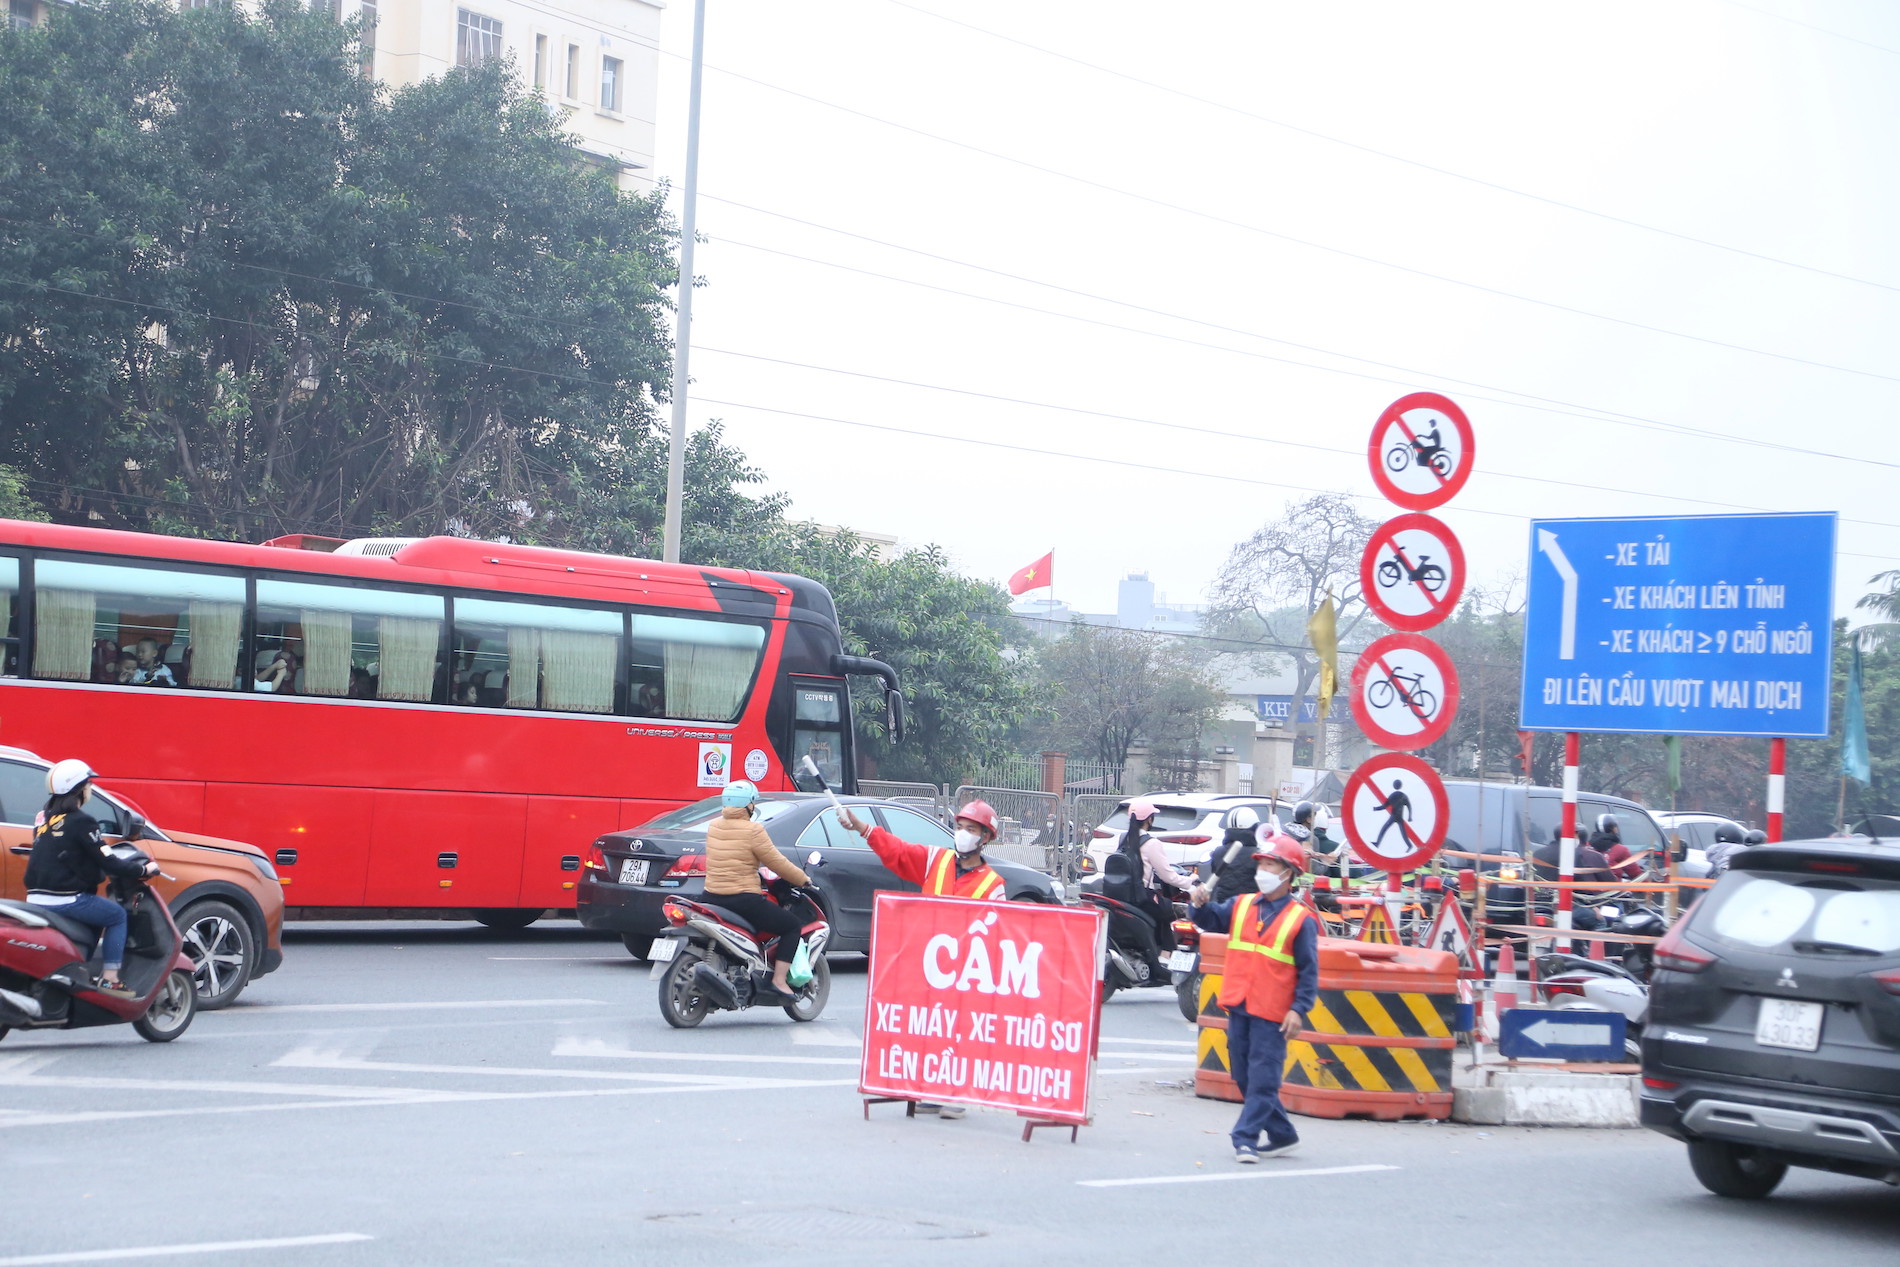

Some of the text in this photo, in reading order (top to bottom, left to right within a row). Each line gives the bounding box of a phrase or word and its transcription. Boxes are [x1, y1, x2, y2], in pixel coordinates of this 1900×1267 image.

[1645, 534, 1670, 565] TẢI
[1640, 579, 1696, 608] KHÁCH
[1701, 580, 1738, 609] LIÊN
[1745, 578, 1784, 608] TỈNH
[1638, 623, 1693, 653] KHÁCH
[1717, 630, 1727, 653] 9
[1732, 621, 1766, 653] CHỖ
[1771, 622, 1812, 654] NGỒI
[1543, 671, 1801, 714] ĐI LÊN CẦU VƯỢT MAI DỊCH
[1304, 703, 1338, 718] VN
[622, 871, 645, 883] 706.44
[629, 861, 642, 872] 29A
[923, 912, 1043, 998] CẤM
[876, 1002, 1082, 1052] XE MÁY, XE THÔ SƠ
[1775, 1002, 1807, 1023] 30F
[1760, 1022, 1817, 1047] 430.33
[880, 1044, 1071, 1102] LÊN CẦU MAI DỊCH
